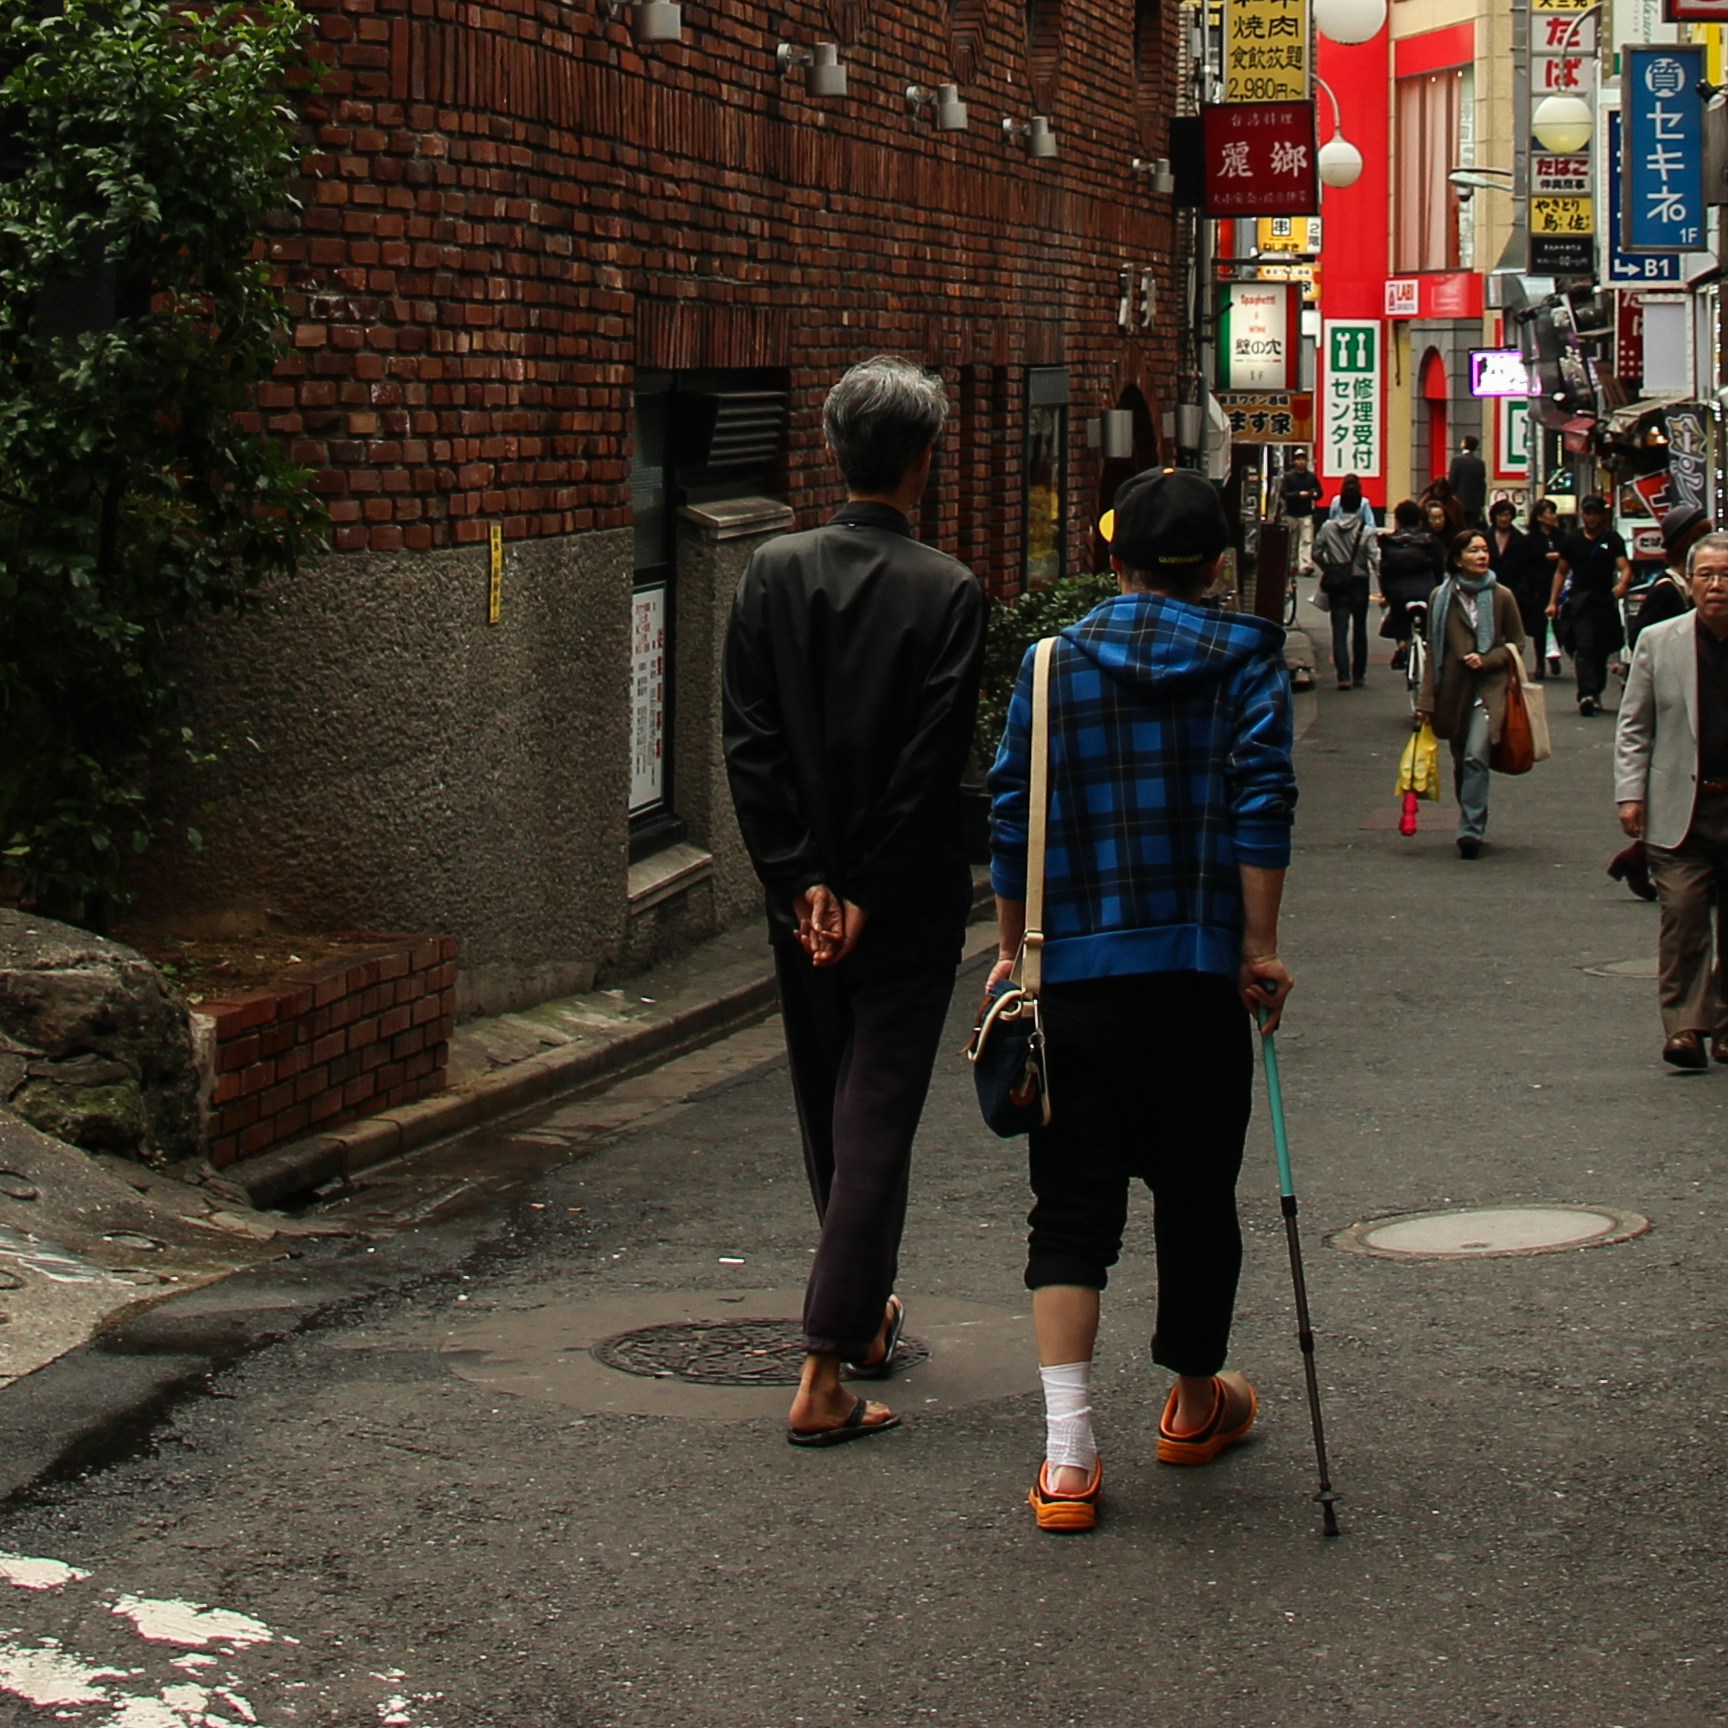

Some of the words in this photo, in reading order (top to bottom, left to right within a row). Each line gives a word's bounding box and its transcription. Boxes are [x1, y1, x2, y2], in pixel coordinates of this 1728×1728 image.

[1234, 16, 1299, 39] 焼肉
[1230, 45, 1303, 71] 食飲放題
[1645, 57, 1685, 98] 質
[1536, 158, 1589, 176] たばこ
[1646, 101, 1686, 223] セキネ
[1534, 198, 1580, 215] やきとり
[1679, 228, 1698, 244] 1F
[1644, 257, 1670, 277] B1
[1228, 410, 1294, 436] ます家
[1330, 379, 1352, 470] センター
[1352, 376, 1375, 470] 修理受付
